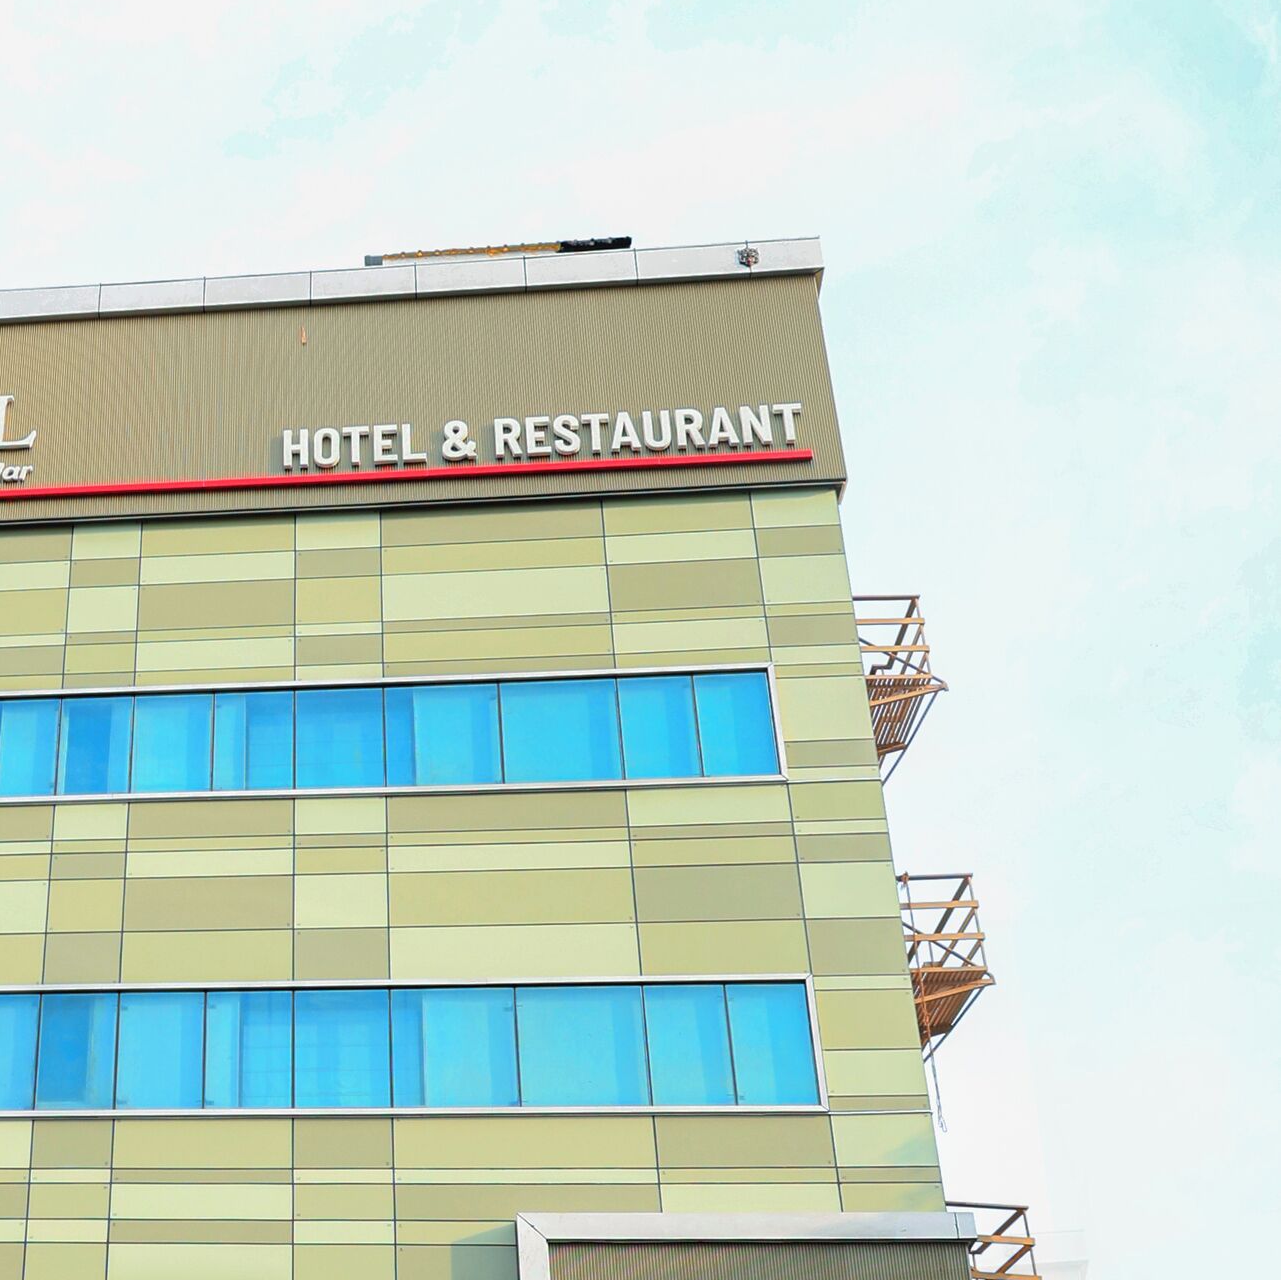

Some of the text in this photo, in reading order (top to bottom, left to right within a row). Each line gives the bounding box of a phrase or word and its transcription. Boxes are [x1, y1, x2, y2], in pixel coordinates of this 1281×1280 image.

[283, 403, 802, 470] HOTEL & RESTAURANT
